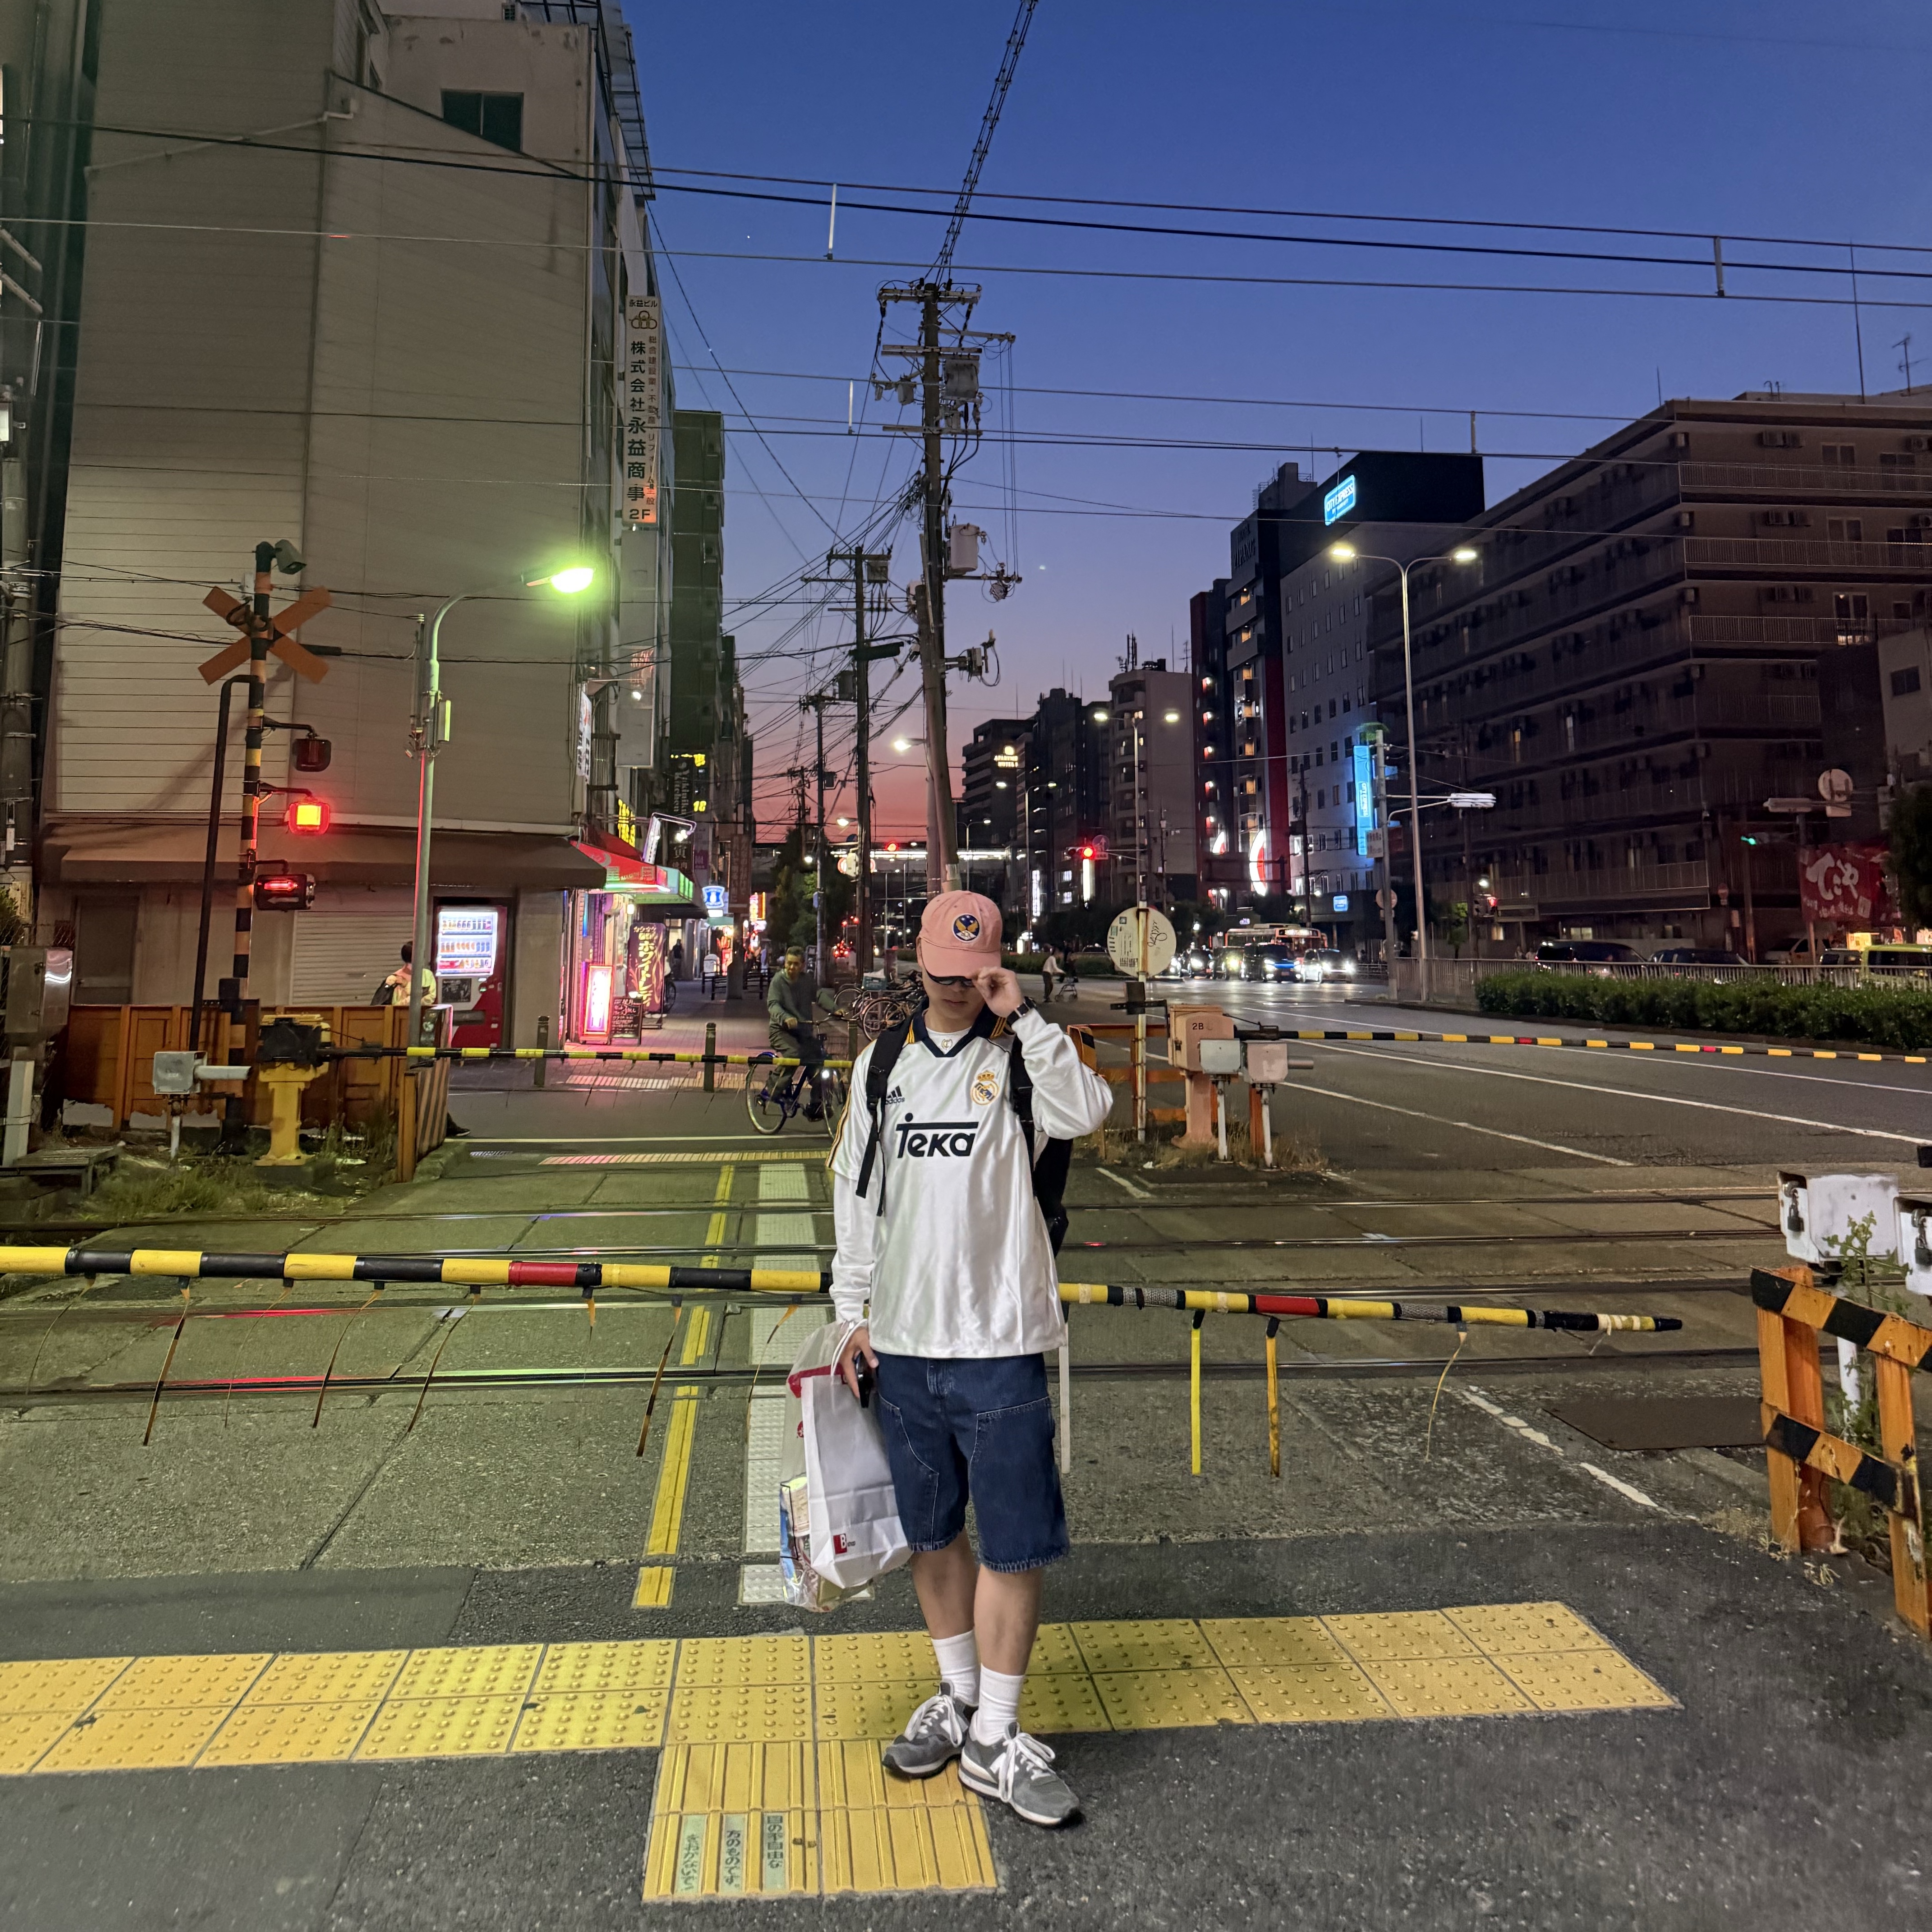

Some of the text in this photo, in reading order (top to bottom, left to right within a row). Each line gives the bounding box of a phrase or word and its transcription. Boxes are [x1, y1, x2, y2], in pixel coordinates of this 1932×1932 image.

[627, 340, 647, 501] 株式会社永益商事
[630, 509, 651, 520] 2F
